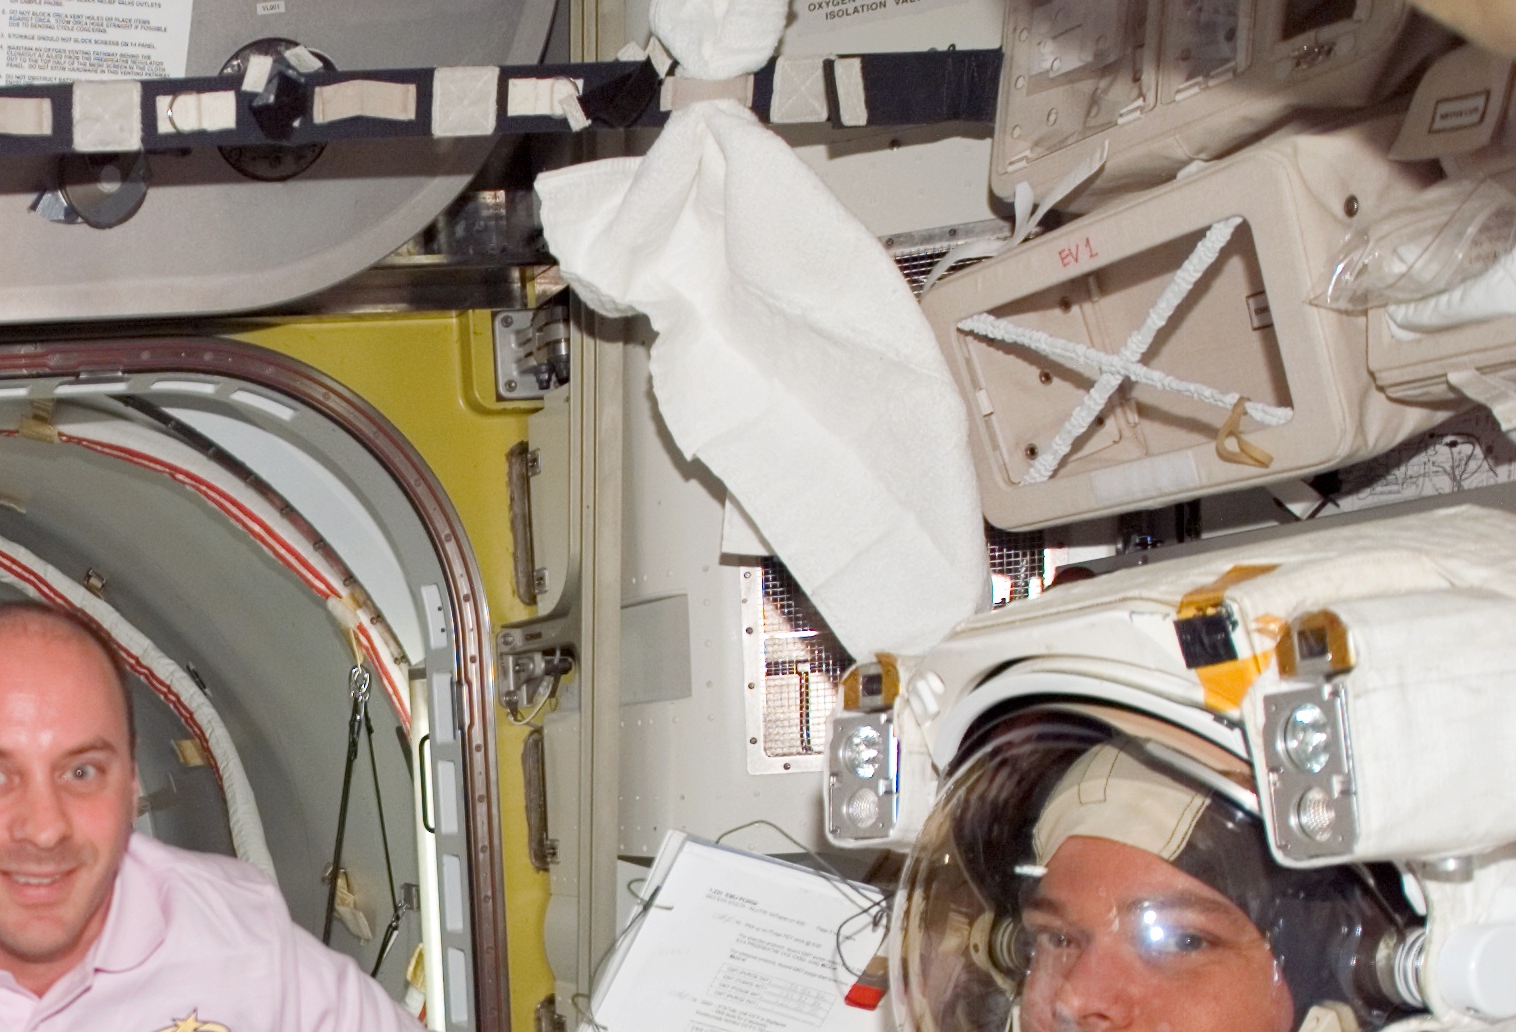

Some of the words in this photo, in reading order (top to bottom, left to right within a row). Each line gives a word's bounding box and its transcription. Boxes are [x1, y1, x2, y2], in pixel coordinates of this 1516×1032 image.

[808, 0, 855, 12] OXYGE
[825, 1, 887, 20] ISOLATION
[1057, 244, 1080, 267] EV
[1085, 237, 1099, 258] 1
